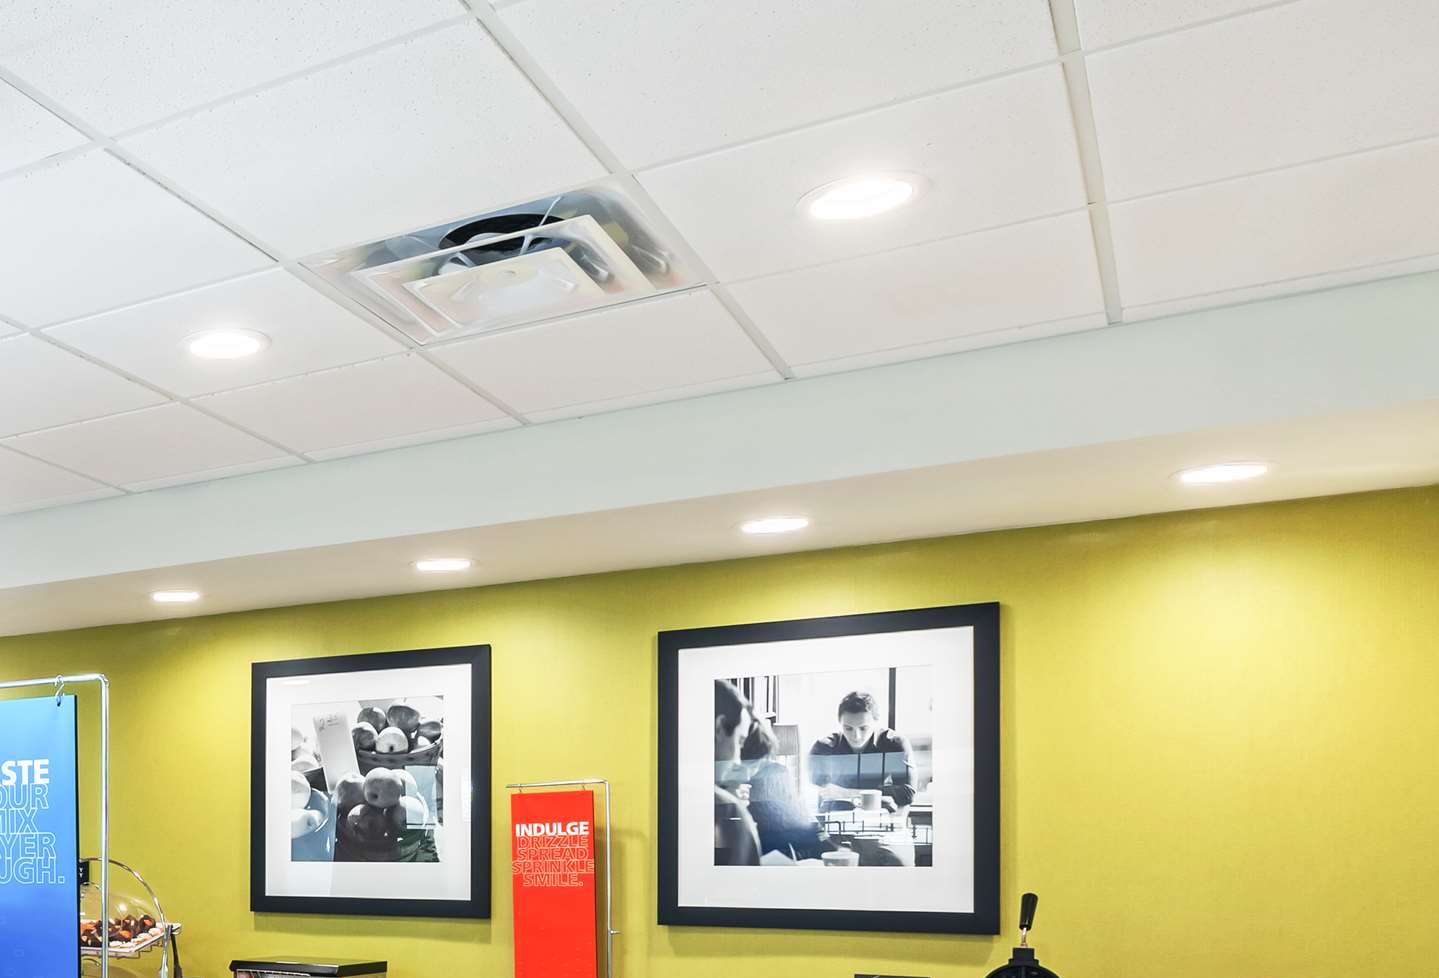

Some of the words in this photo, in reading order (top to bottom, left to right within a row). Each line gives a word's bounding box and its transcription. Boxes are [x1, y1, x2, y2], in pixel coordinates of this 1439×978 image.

[515, 821, 590, 838] INDULGE
[517, 835, 590, 850] DRIZZLE
[516, 847, 590, 863] SPREAD
[511, 858, 596, 875] SPRINKLE
[522, 871, 585, 888] SMILE.
